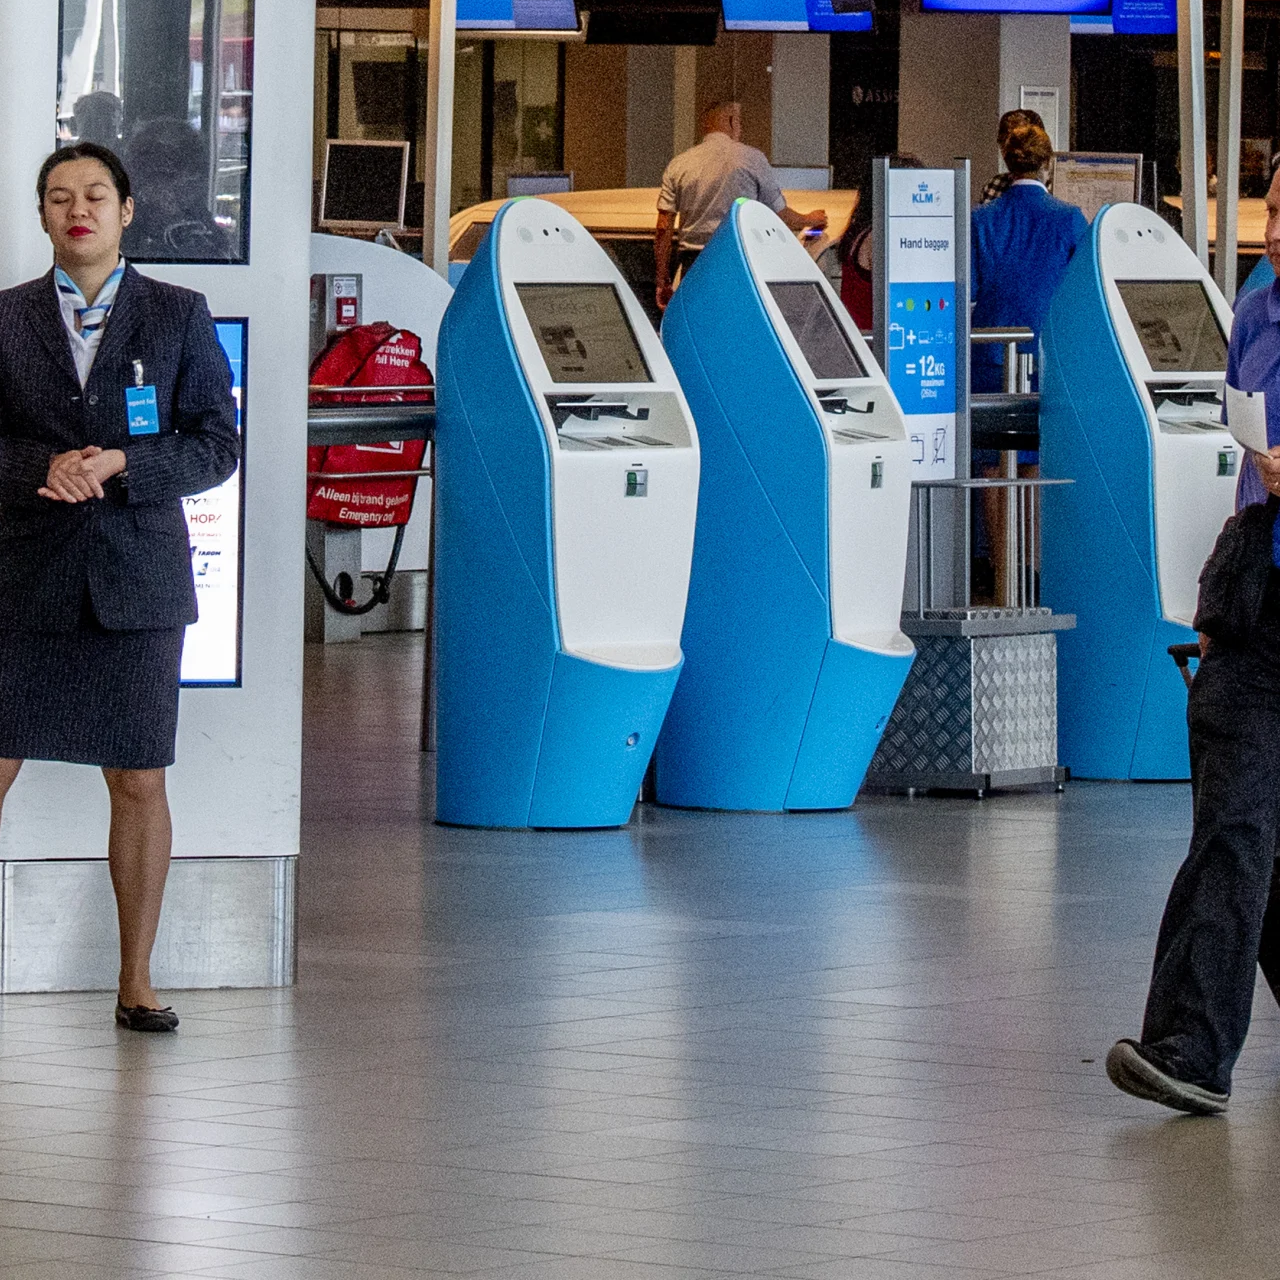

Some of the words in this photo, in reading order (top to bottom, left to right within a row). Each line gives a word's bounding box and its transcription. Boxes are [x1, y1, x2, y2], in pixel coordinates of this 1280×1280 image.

[912, 193, 933, 204] KLM
[900, 237, 922, 249] Hand
[924, 237, 949, 251] baggage
[389, 355, 410, 368] Here
[316, 486, 350, 503] Alleen
